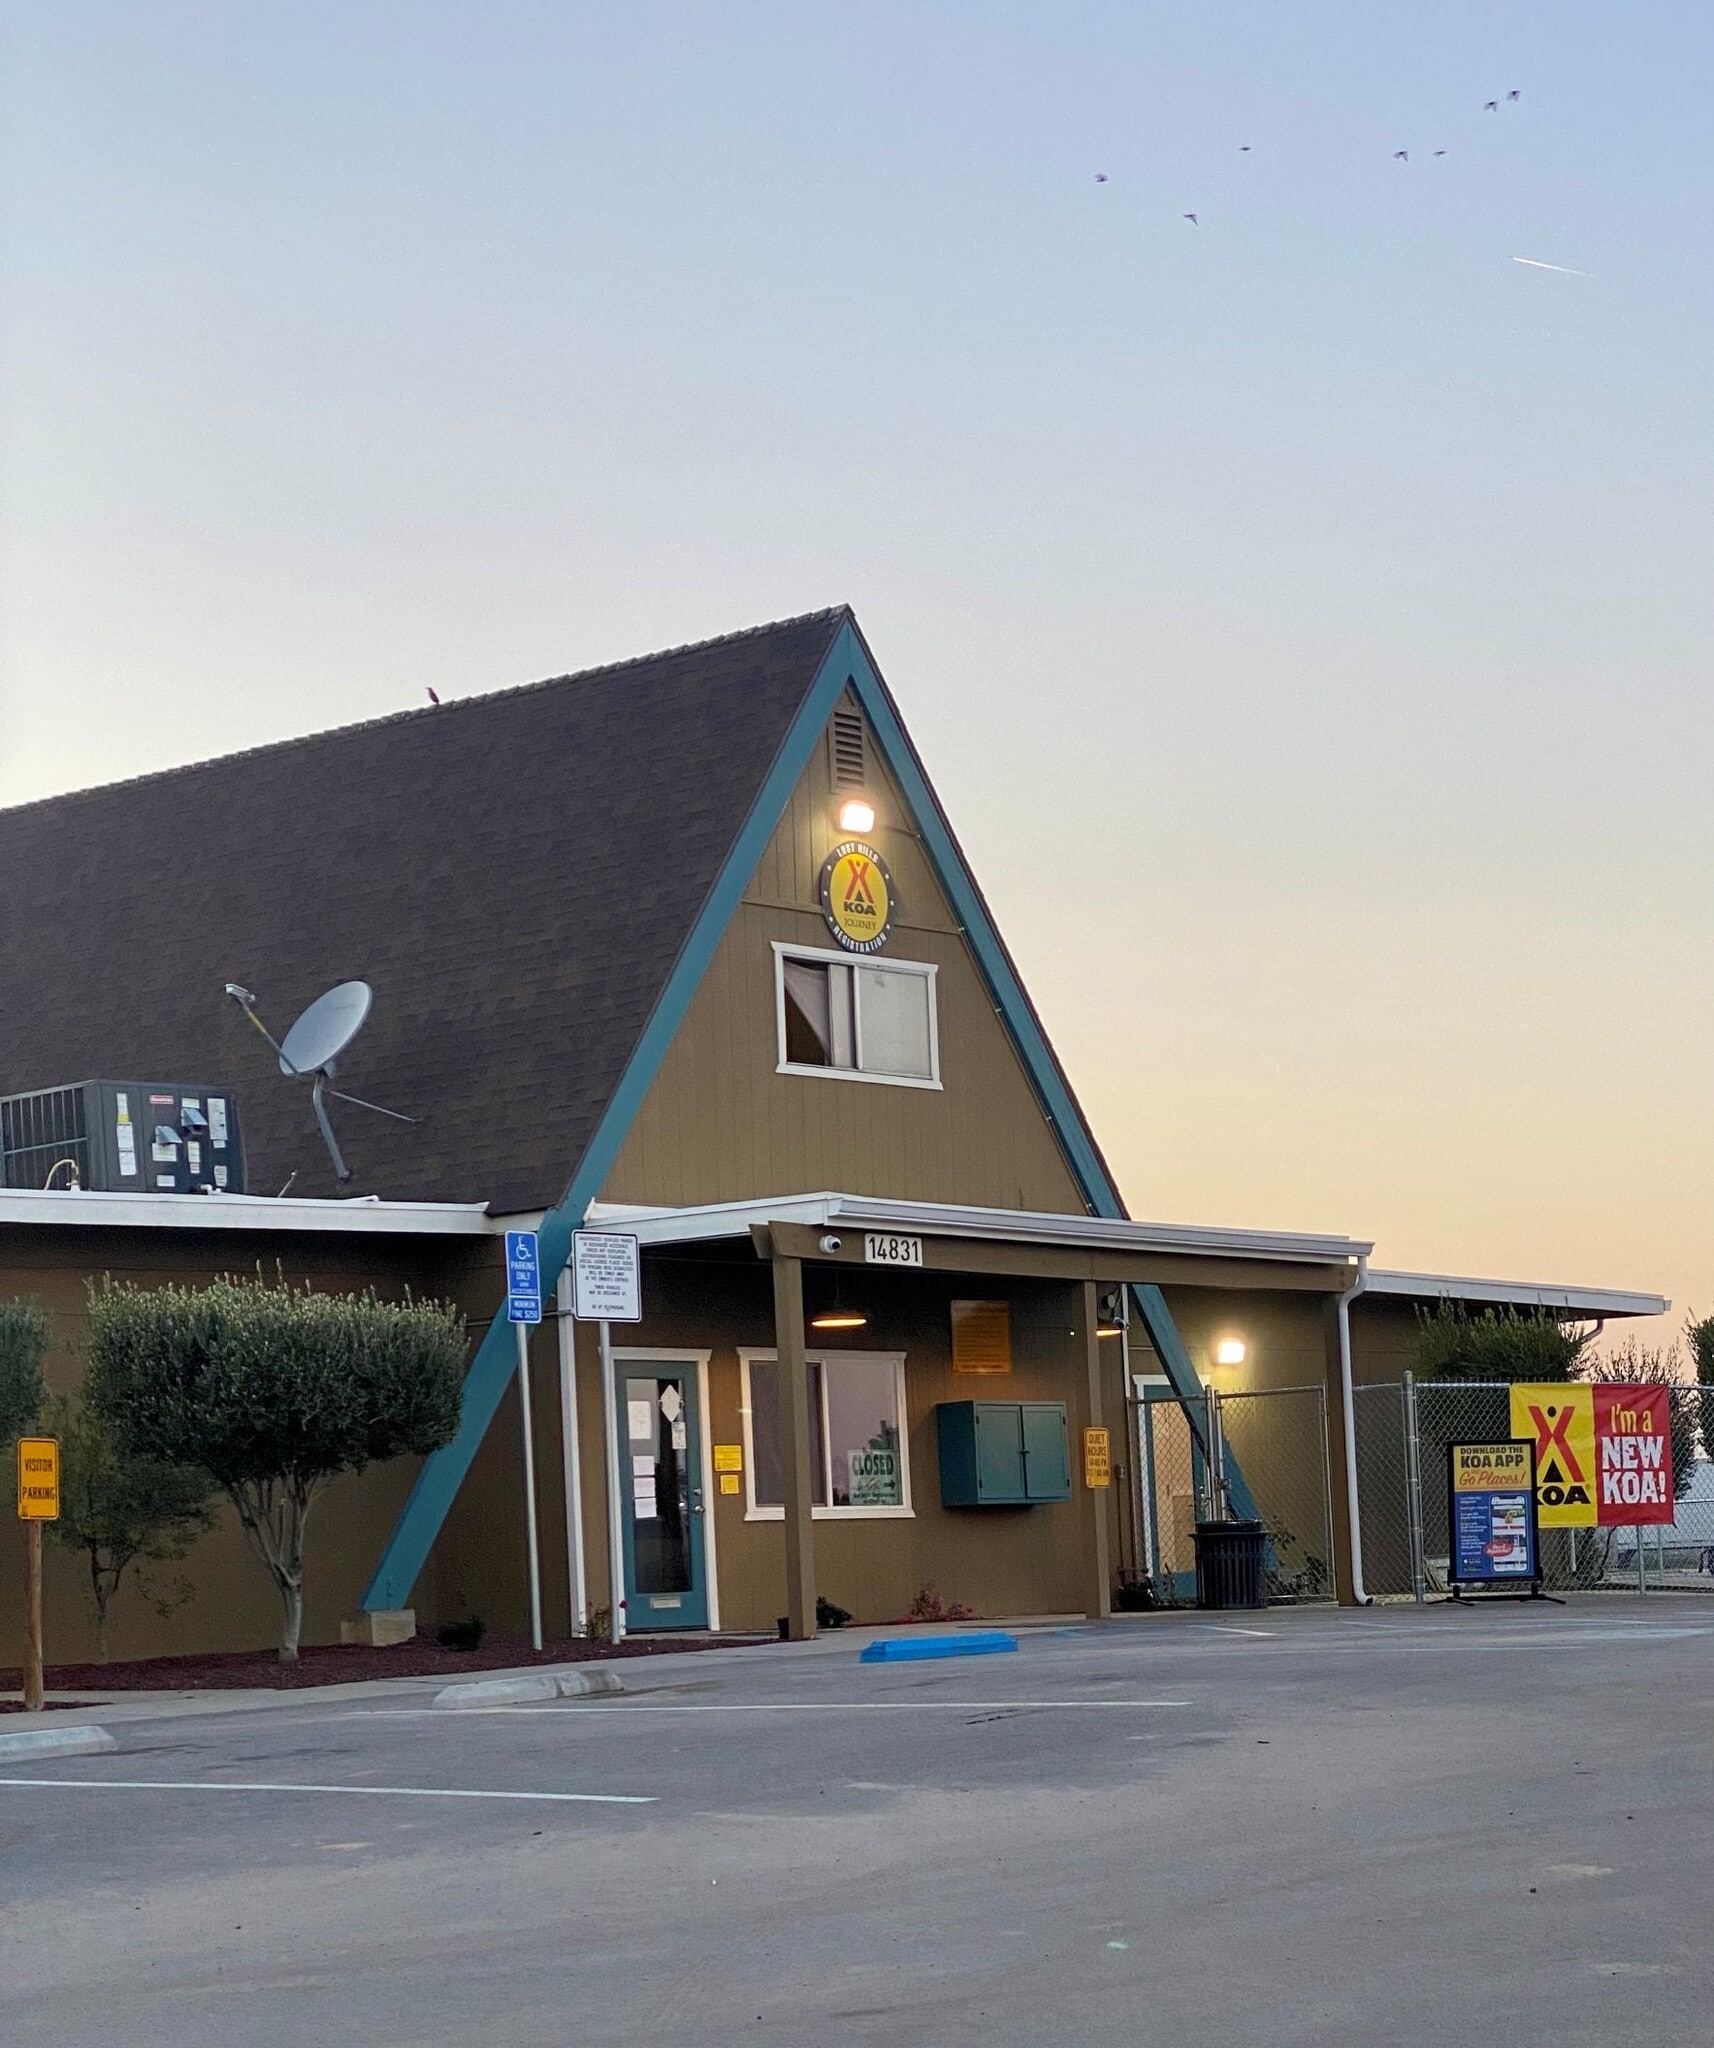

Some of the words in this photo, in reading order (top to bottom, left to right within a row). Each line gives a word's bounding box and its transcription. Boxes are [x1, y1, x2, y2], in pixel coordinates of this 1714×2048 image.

[837, 843, 855, 857] LOST
[858, 844, 879, 863] HILLS
[844, 902, 876, 916] KOA
[845, 918, 876, 931] JOURNEY
[833, 925, 887, 953] REGISTRATION
[869, 1237, 918, 1263] 14831
[511, 1260, 536, 1271] PARKING
[516, 1271, 531, 1281] ONLY
[512, 1309, 523, 1318] FINE
[1611, 1403, 1637, 1433] I'm
[1643, 1410, 1652, 1433] a
[1088, 1433, 1105, 1444] QUIET
[1087, 1446, 1107, 1456] HOURS
[1509, 1446, 1524, 1454] THE
[1601, 1435, 1664, 1469] NEW
[24, 1458, 53, 1472] VISITOR
[852, 1454, 894, 1476] CLOSED
[1461, 1455, 1492, 1468] KOA
[1494, 1454, 1524, 1468] APP
[1459, 1471, 1476, 1486] Go
[1477, 1469, 1527, 1485] Places!
[22, 1486, 55, 1499] PARKING
[1602, 1471, 1667, 1504] KOA!
